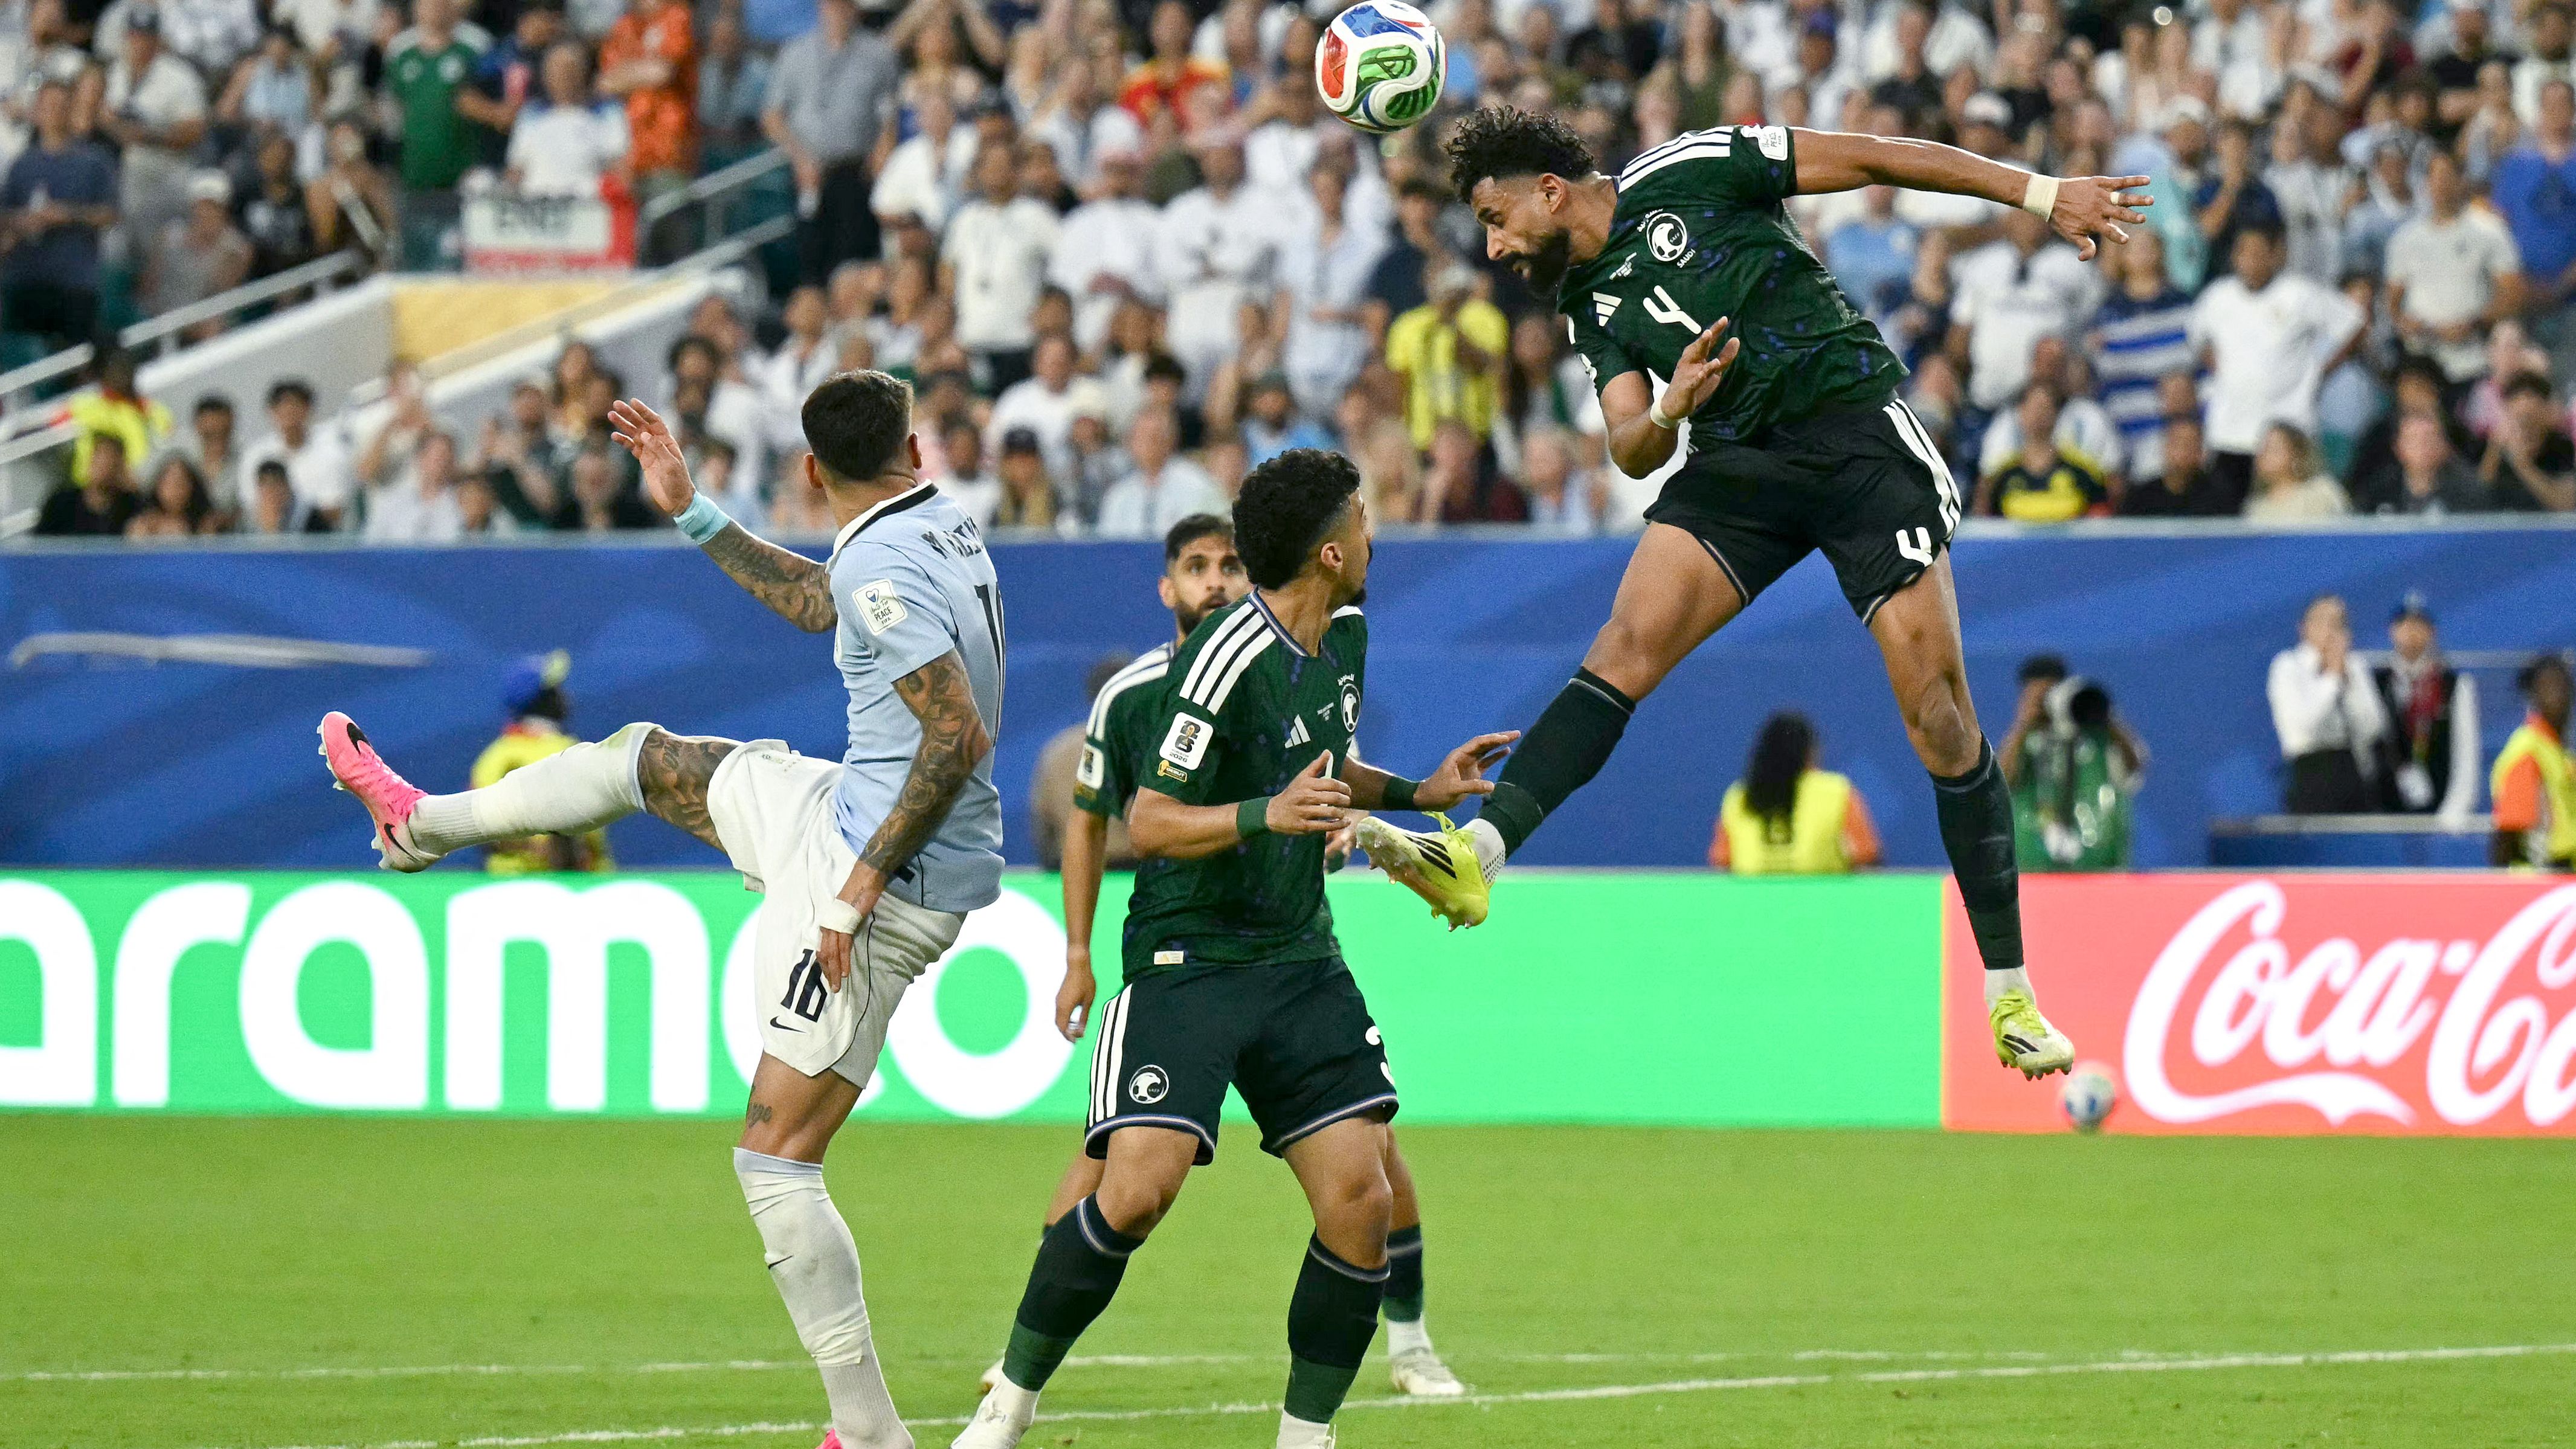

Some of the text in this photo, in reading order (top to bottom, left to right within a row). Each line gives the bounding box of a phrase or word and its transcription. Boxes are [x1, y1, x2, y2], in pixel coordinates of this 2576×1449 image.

[1676, 248, 1696, 268] SAUDI
[1643, 284, 1702, 335] 4
[1895, 526, 1934, 568] 4
[874, 606, 893, 622] PEACE
[0, 879, 1080, 1120] aramo
